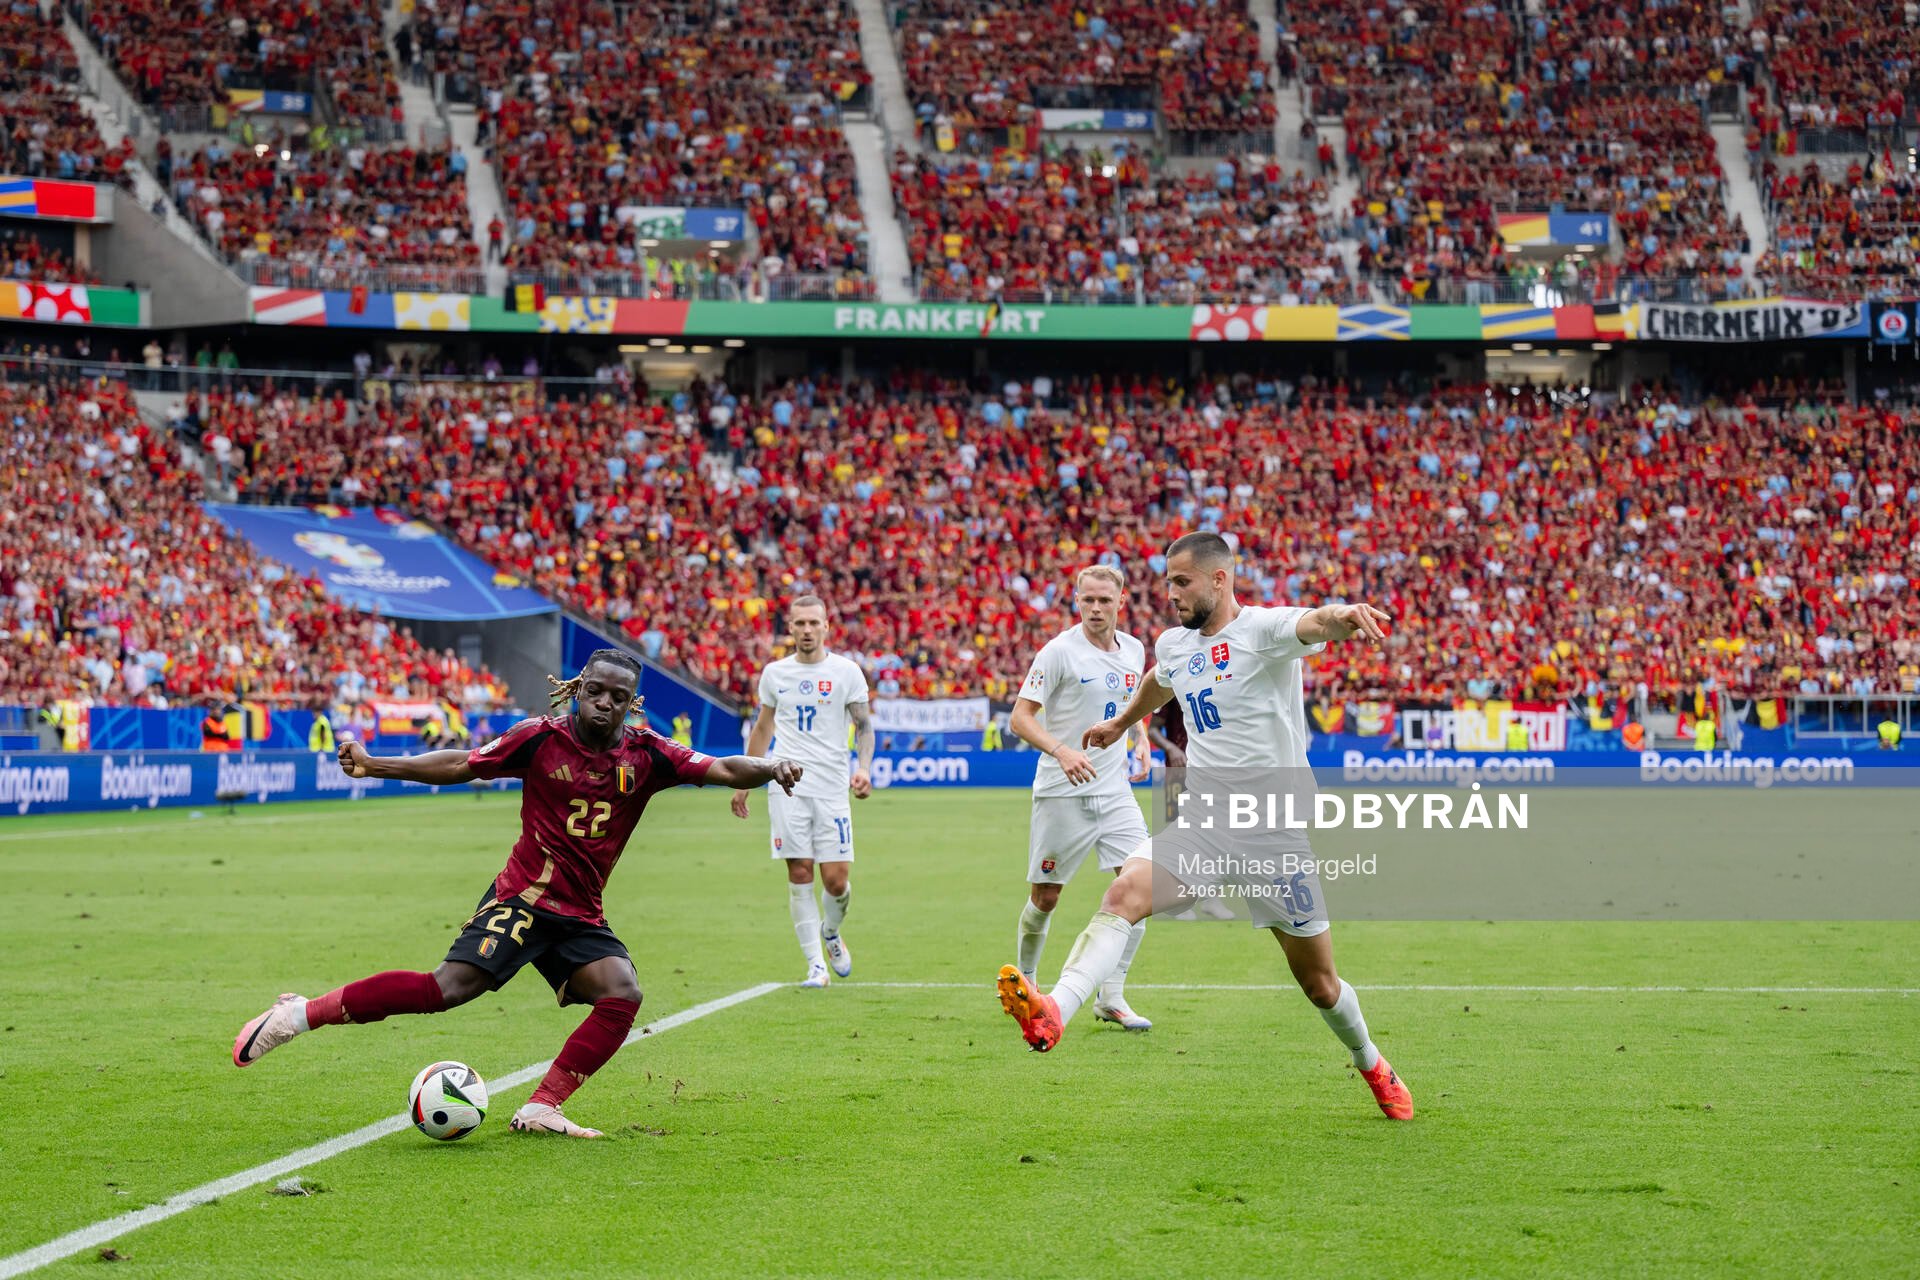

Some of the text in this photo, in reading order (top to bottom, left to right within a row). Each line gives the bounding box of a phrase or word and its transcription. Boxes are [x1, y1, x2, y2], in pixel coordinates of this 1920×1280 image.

[714, 217, 739, 233] 37
[1579, 221, 1603, 237] 41
[834, 307, 1046, 333] FRANKFURT
[795, 704, 818, 732] 17
[1185, 687, 1222, 734] 16
[101, 755, 192, 808] Booking.com
[217, 752, 296, 803] Booking.com
[1343, 749, 1555, 788] Booking.com
[1640, 749, 1855, 788] Booking.com
[566, 798, 612, 838] 22
[1273, 870, 1315, 916] 16
[486, 906, 534, 946] 22
